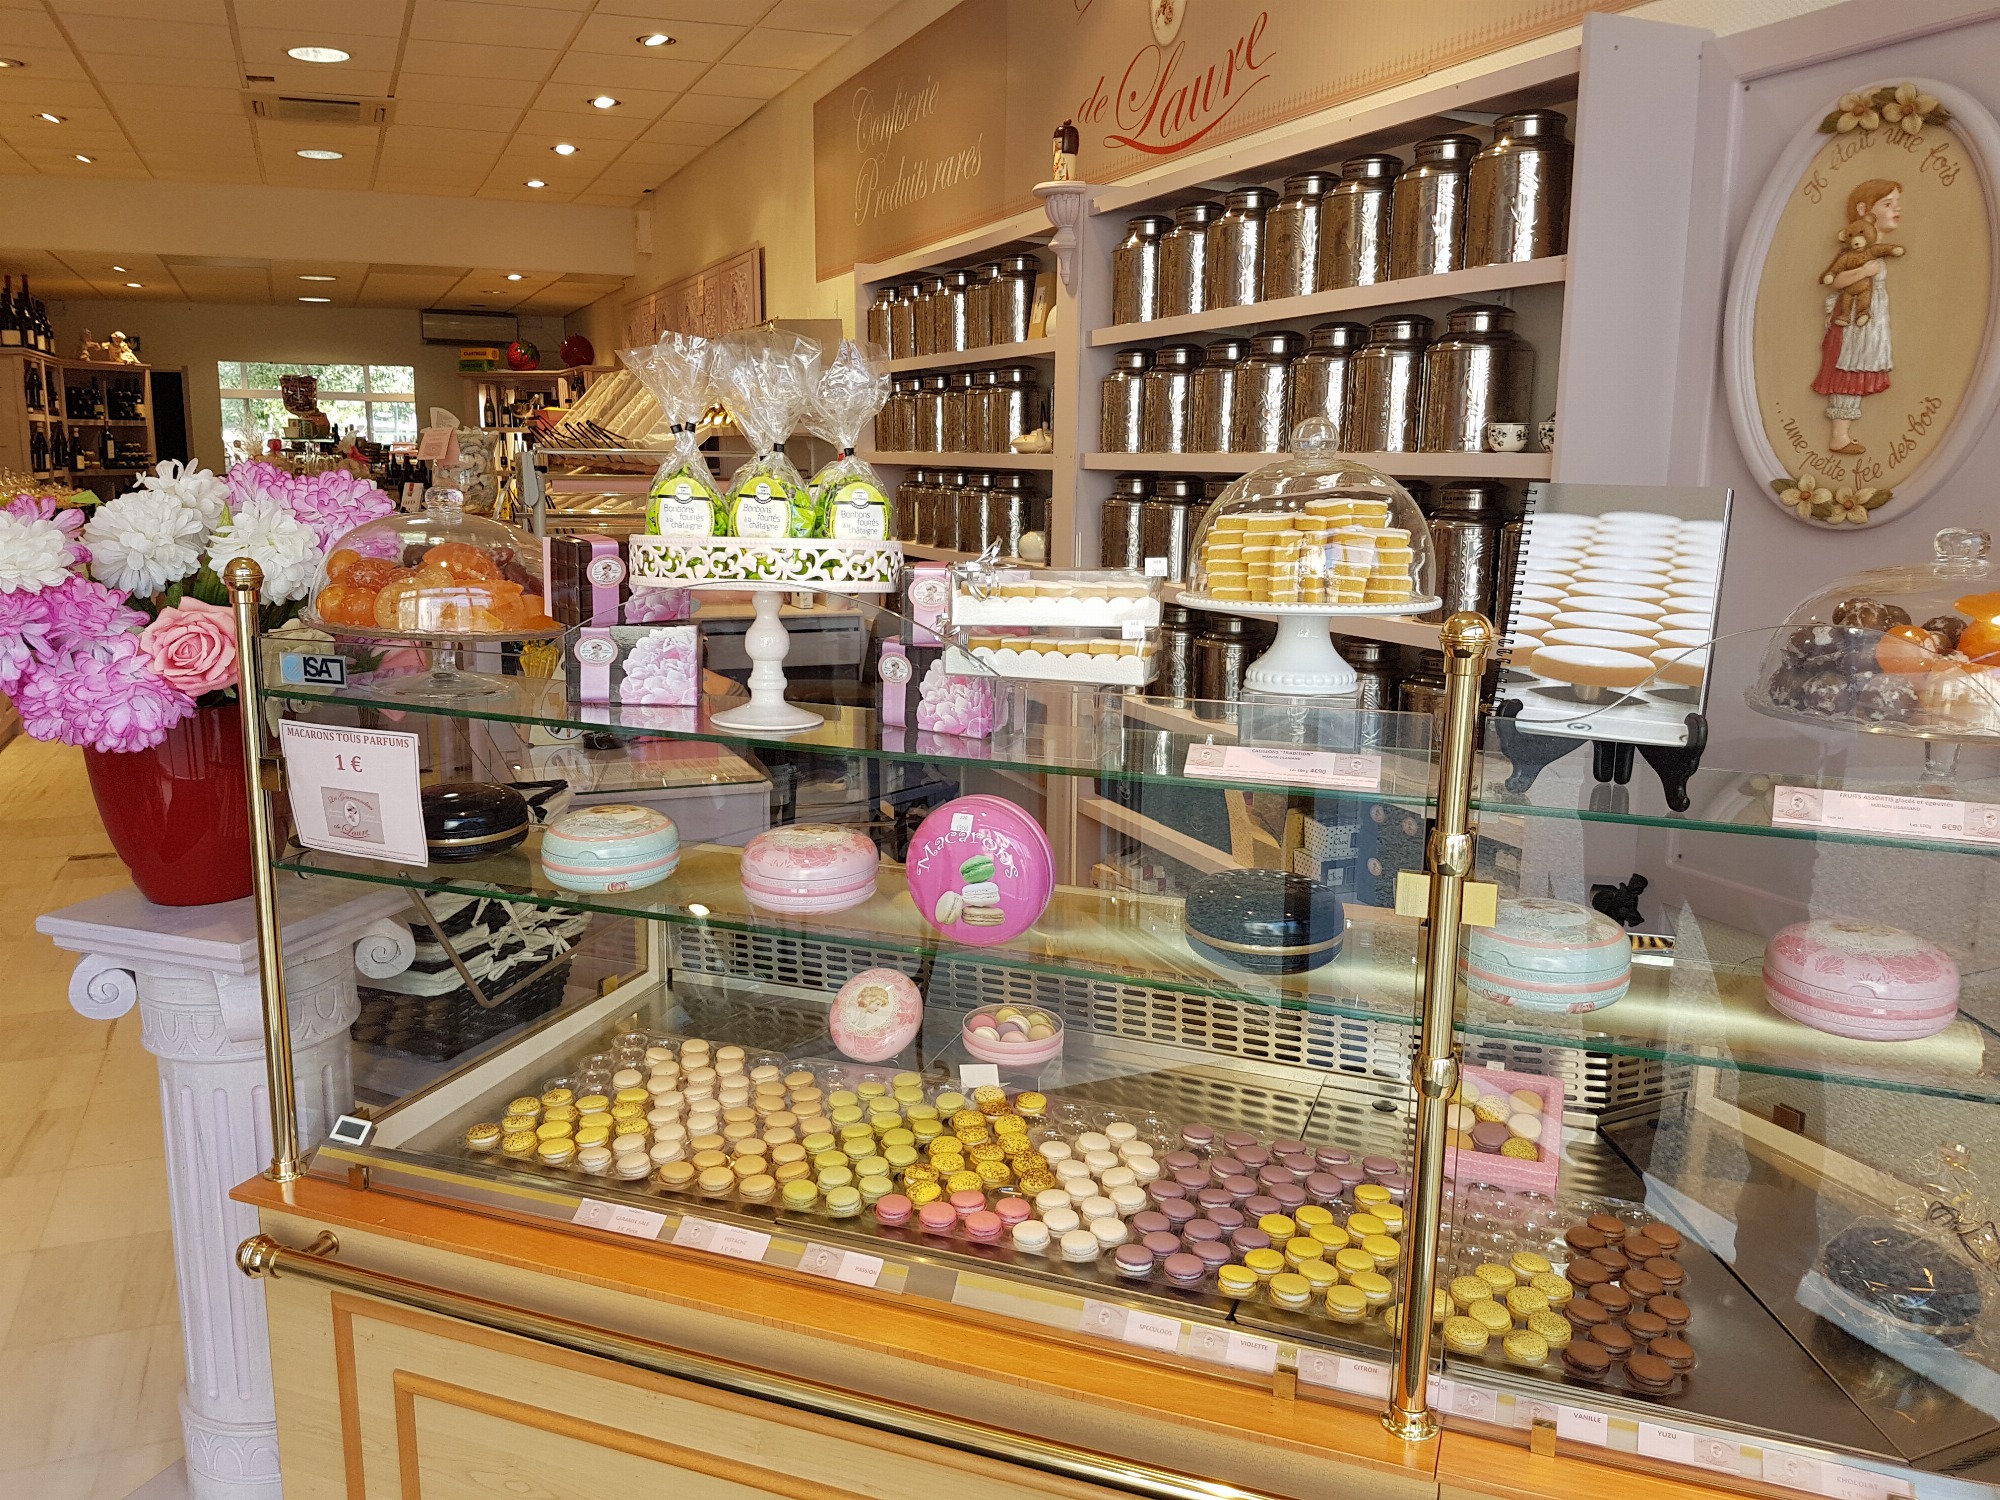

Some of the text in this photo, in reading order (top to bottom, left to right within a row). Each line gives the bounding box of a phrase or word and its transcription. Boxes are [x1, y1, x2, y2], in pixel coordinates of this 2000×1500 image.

[1077, 12, 1276, 155] de Laure
[851, 77, 941, 155] Confiserie
[1828, 130, 1876, 173] était
[1884, 126, 1924, 154] une
[1919, 142, 1962, 188] fois
[853, 134, 985, 226] Produits rares
[1797, 447, 1848, 483] petite
[1852, 453, 1884, 490] fée
[1887, 430, 1918, 468] des
[1907, 394, 1944, 438] bois
[663, 503, 695, 514] Bonbons
[743, 503, 772, 514] Bonbons
[841, 510, 871, 519] Bonbons
[679, 512, 705, 522] fourrés
[757, 513, 781, 523] fourrés
[857, 518, 880, 527] fourrés
[671, 521, 703, 531] châtaigne
[749, 522, 779, 532] châtaigne
[849, 527, 878, 536] châtaigne
[303, 656, 332, 678] ISA
[286, 726, 410, 748] MACARONS TOUS PARFUMS
[335, 754, 363, 773] 1 €
[1839, 792, 1862, 800] FRUITS
[1863, 794, 1894, 803] ASSORTIS
[1895, 796, 1918, 805] glacés
[1925, 799, 1954, 809] égouttés
[340, 824, 371, 839] Laure
[1941, 823, 1963, 831] 6€90
[916, 829, 1019, 879] Macarons
[854, 1265, 878, 1277] PASSION
[1138, 1323, 1173, 1337] SPECULOOS
[1240, 1339, 1269, 1351] VIOLETTE
[1353, 1363, 1379, 1374] CITRON
[1573, 1412, 1602, 1424] VANILLE
[1657, 1430, 1678, 1440] YUZU
[1836, 1476, 1879, 1490] CHOCOLAT
